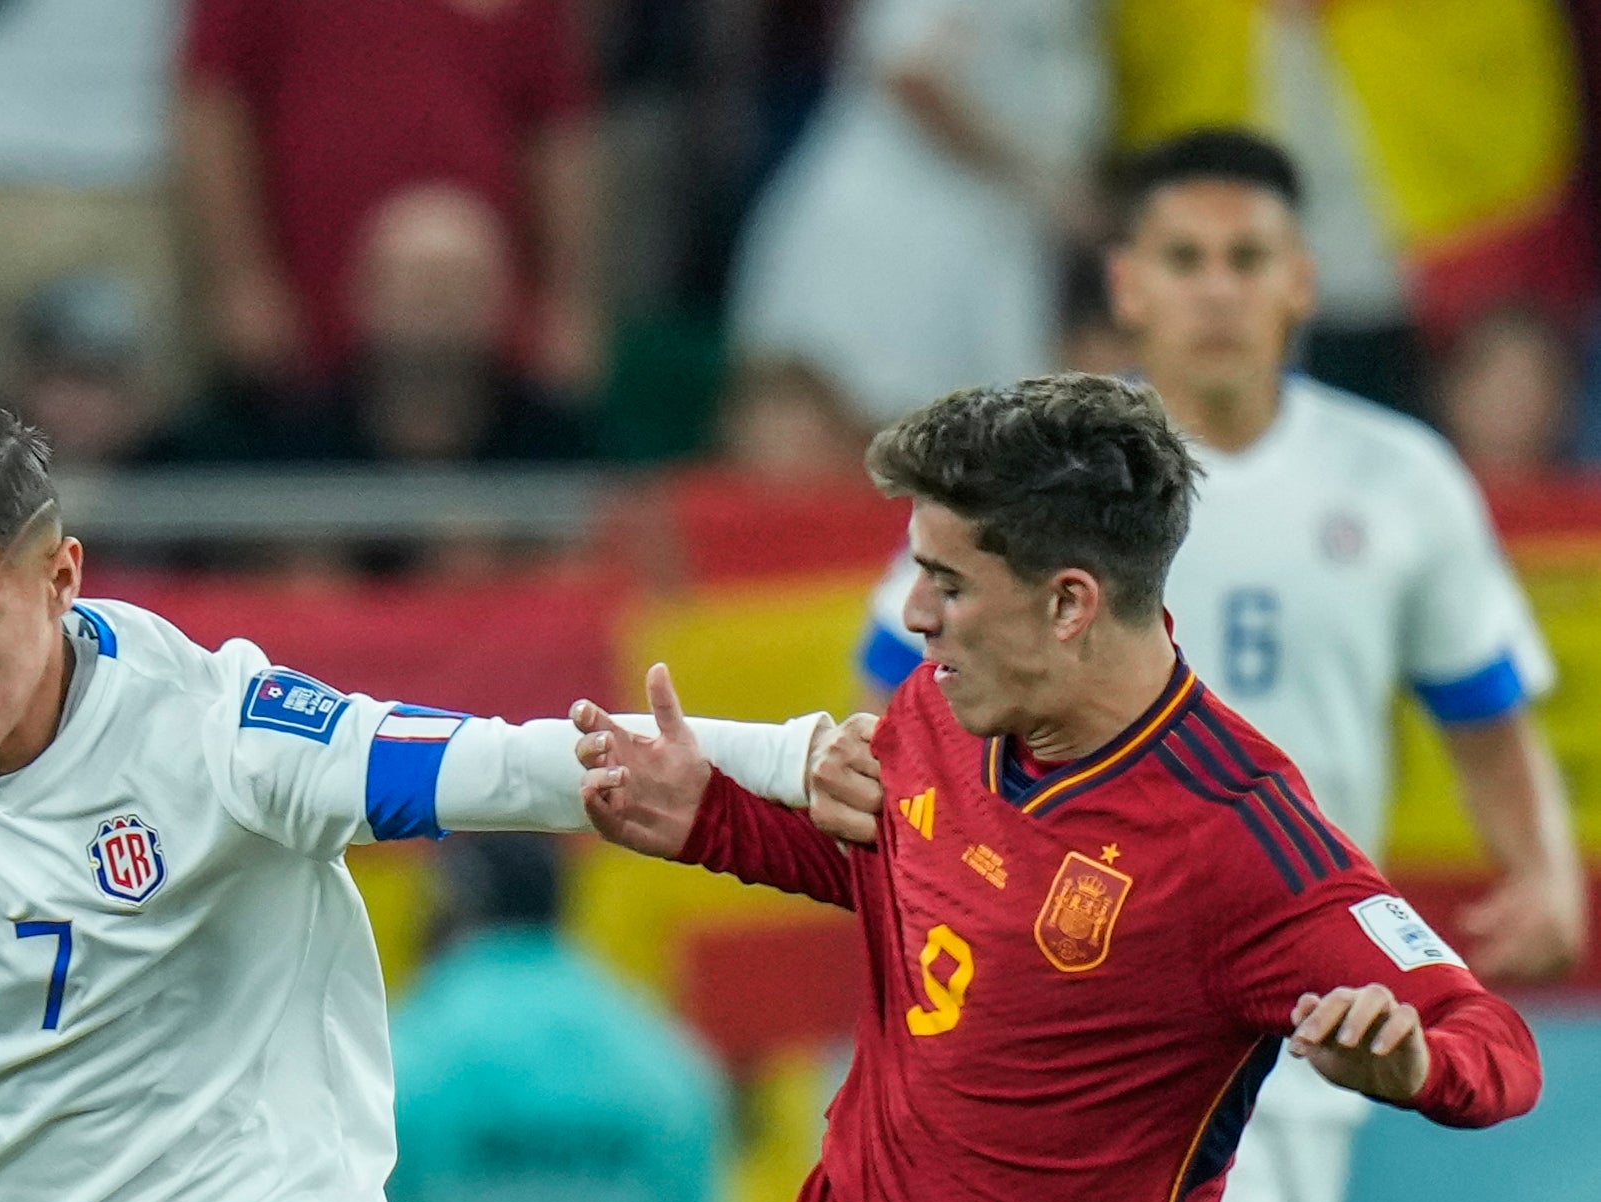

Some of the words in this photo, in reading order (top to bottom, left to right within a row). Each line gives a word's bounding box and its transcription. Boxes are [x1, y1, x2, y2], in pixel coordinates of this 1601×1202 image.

[1222, 585, 1281, 697] 6
[105, 833, 152, 890] CR
[14, 920, 73, 1030] 7
[906, 923, 975, 1036] 9
